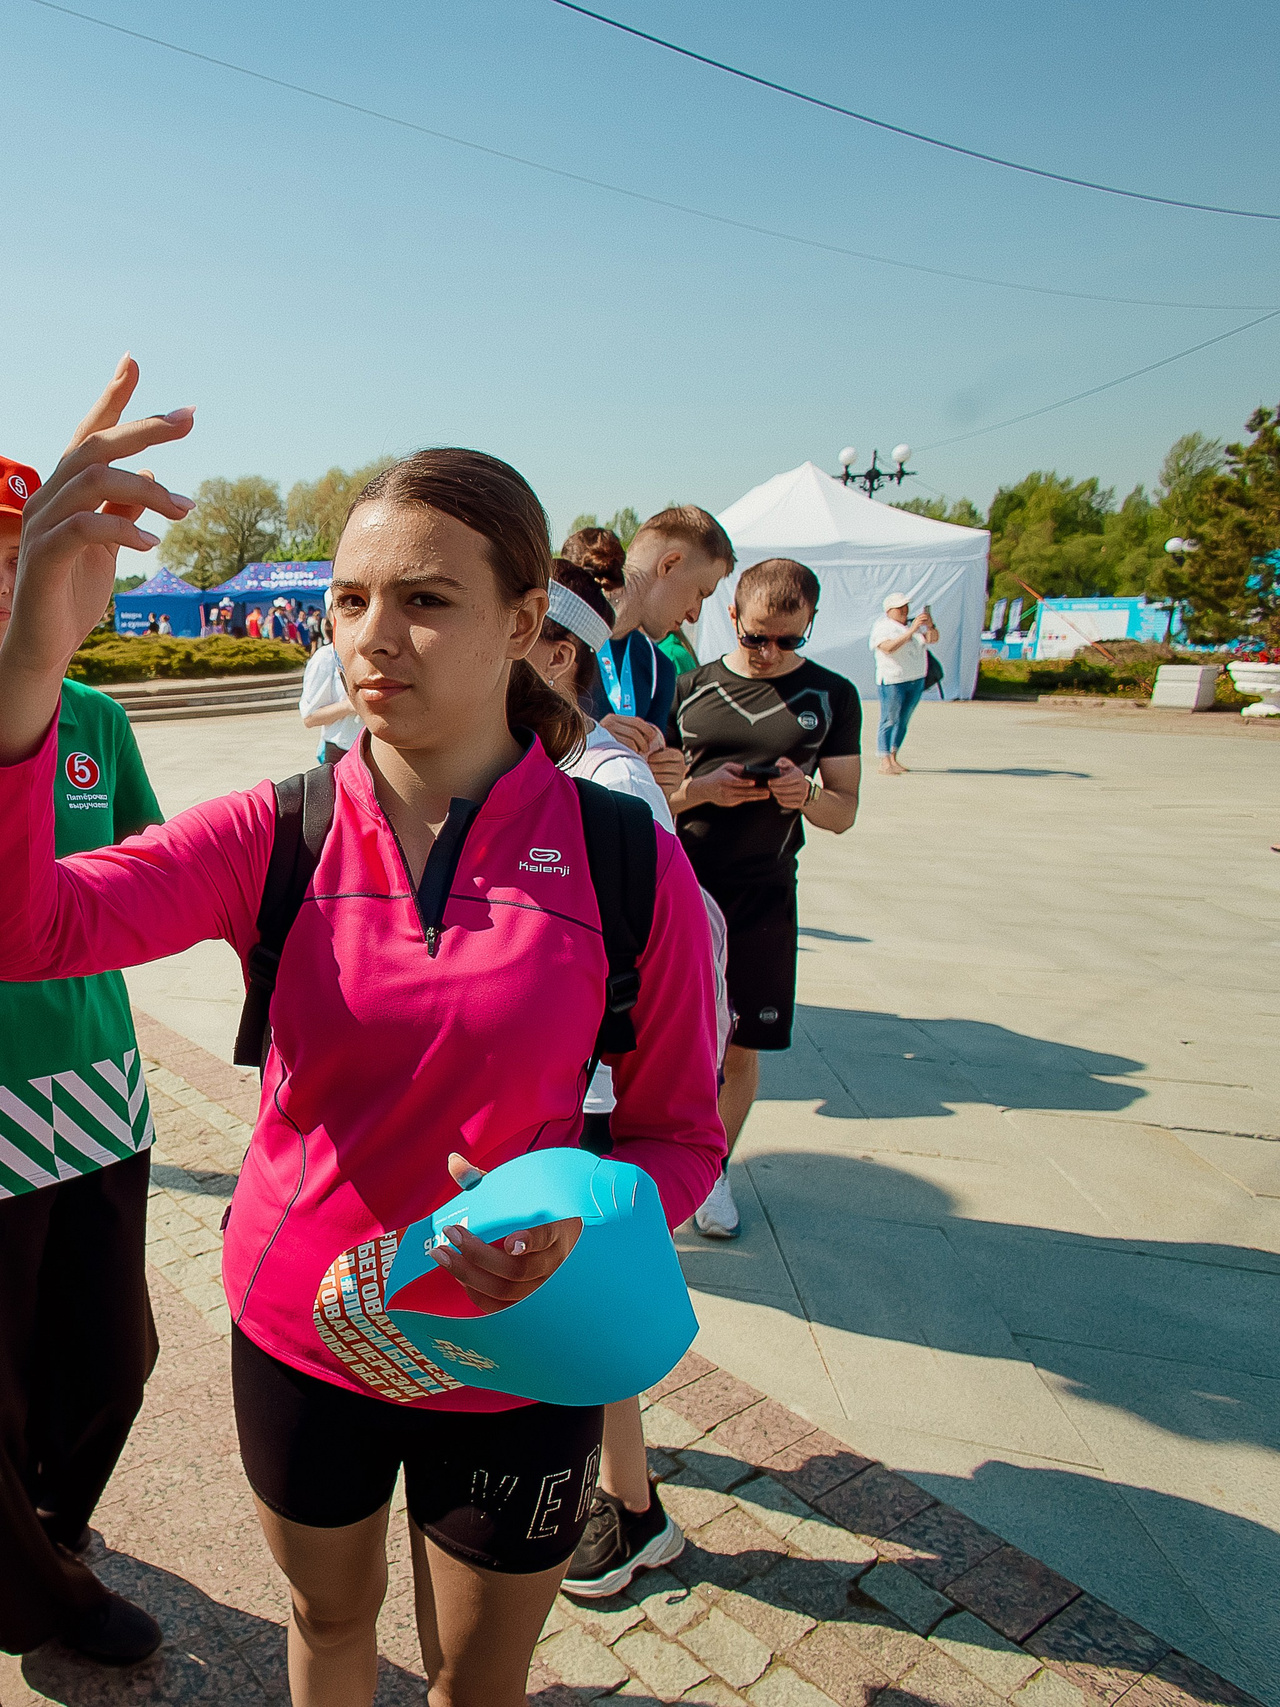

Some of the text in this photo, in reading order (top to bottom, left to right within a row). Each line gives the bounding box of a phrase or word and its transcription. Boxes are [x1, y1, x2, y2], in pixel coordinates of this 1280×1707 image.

[519, 861, 570, 877] Kalenji
[357, 1241, 401, 1336] БЕГОВАЯ
[340, 1276, 392, 1348] #ЛЮБИ
[383, 1347, 426, 1374] БЕГ
[349, 1362, 389, 1387] БЕГ
